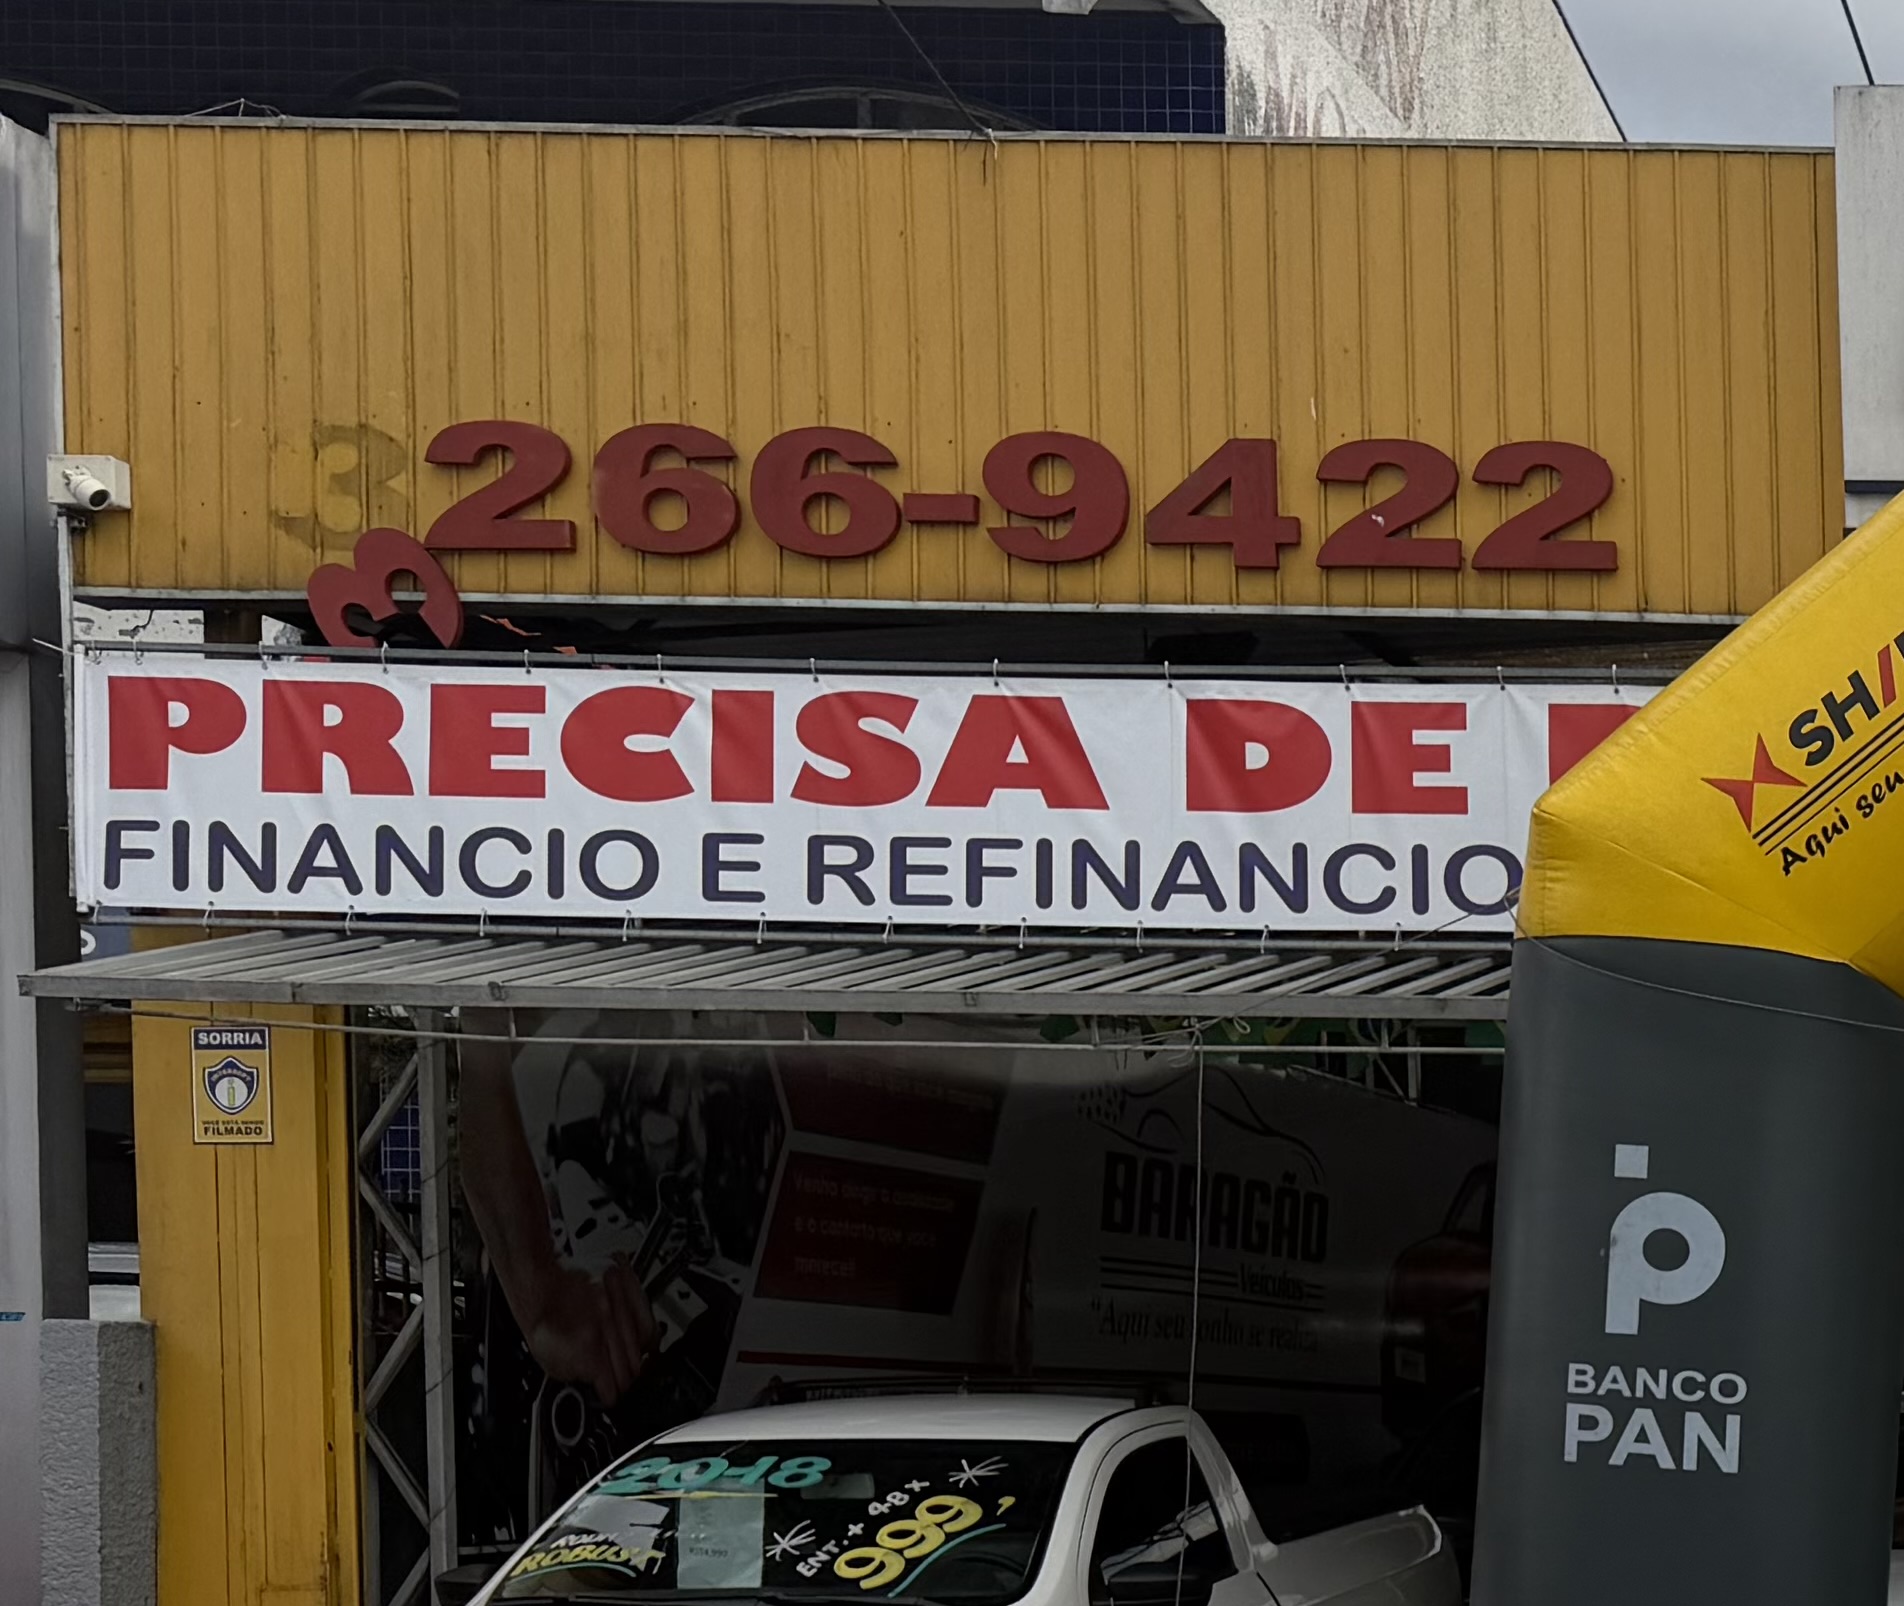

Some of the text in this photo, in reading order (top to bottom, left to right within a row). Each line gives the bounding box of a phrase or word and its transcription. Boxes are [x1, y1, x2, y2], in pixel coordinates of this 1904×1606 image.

[107, 674, 1111, 811] PRECISA
[1186, 699, 1469, 816] DE
[103, 819, 660, 902] FINANCIO
[702, 832, 766, 904] E
[807, 833, 1524, 917] REFINANCIO
[1780, 806, 1851, 876] Aqui
[197, 1031, 264, 1046] SORRIA
[203, 1126, 264, 1137] FILMADO
[1100, 1149, 1330, 1265] BARAGÃO
[1566, 1362, 1749, 1405] BANCO
[1562, 1403, 1742, 1475] PAN
